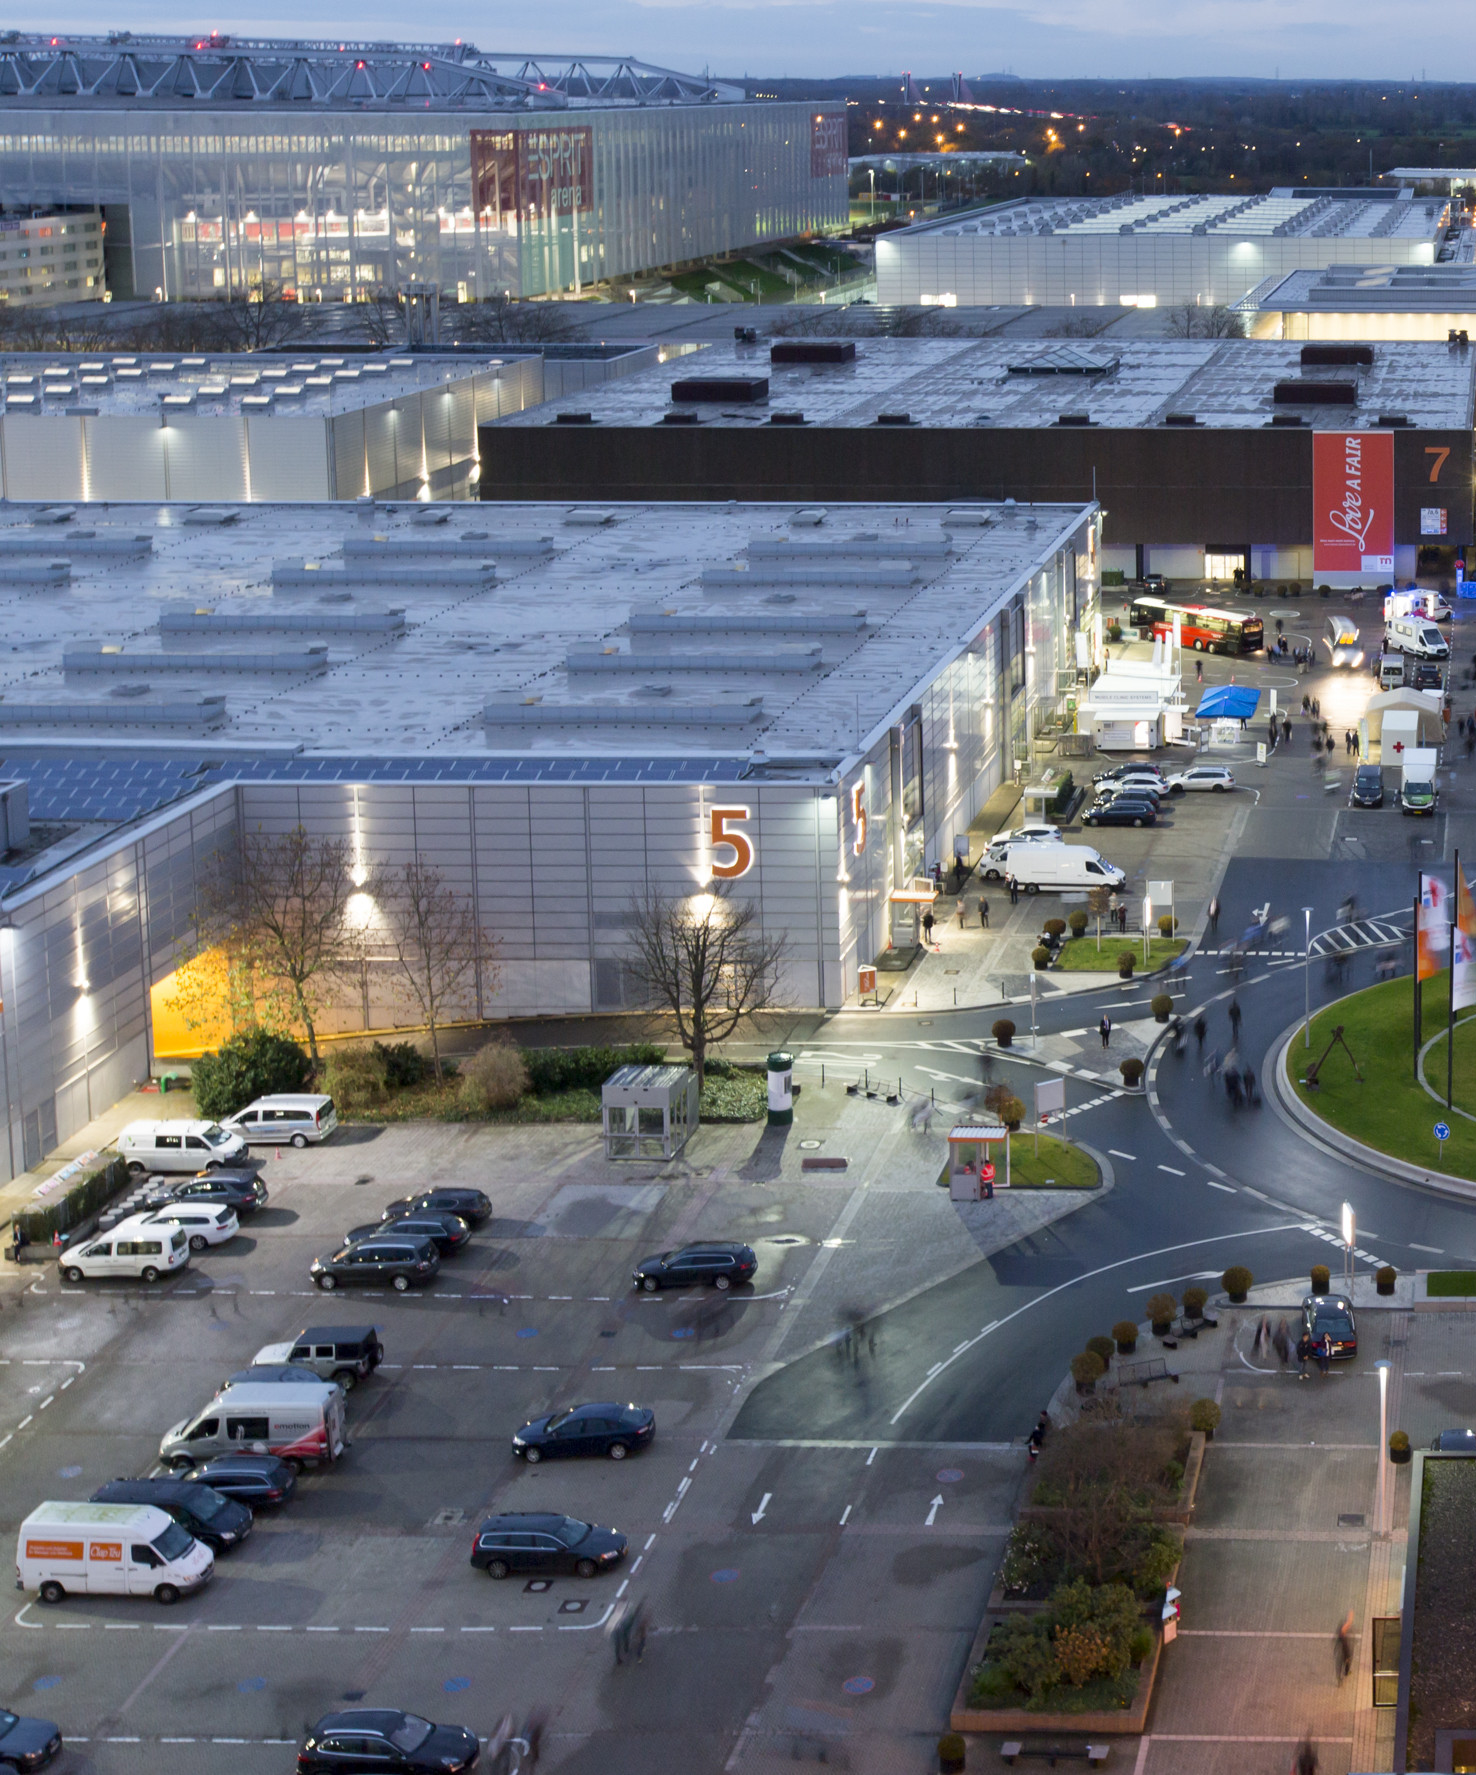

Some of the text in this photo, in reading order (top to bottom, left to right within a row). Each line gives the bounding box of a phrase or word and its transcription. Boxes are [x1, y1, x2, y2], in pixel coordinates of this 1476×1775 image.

[528, 133, 586, 180] ESPRIT
[550, 185, 582, 209] arena
[1345, 437, 1361, 476] FAIR
[1424, 446, 1451, 483] 7
[1345, 479, 1361, 491] A
[1329, 492, 1375, 552] Love
[711, 805, 754, 878] 5
[273, 1422, 311, 1430] emotion
